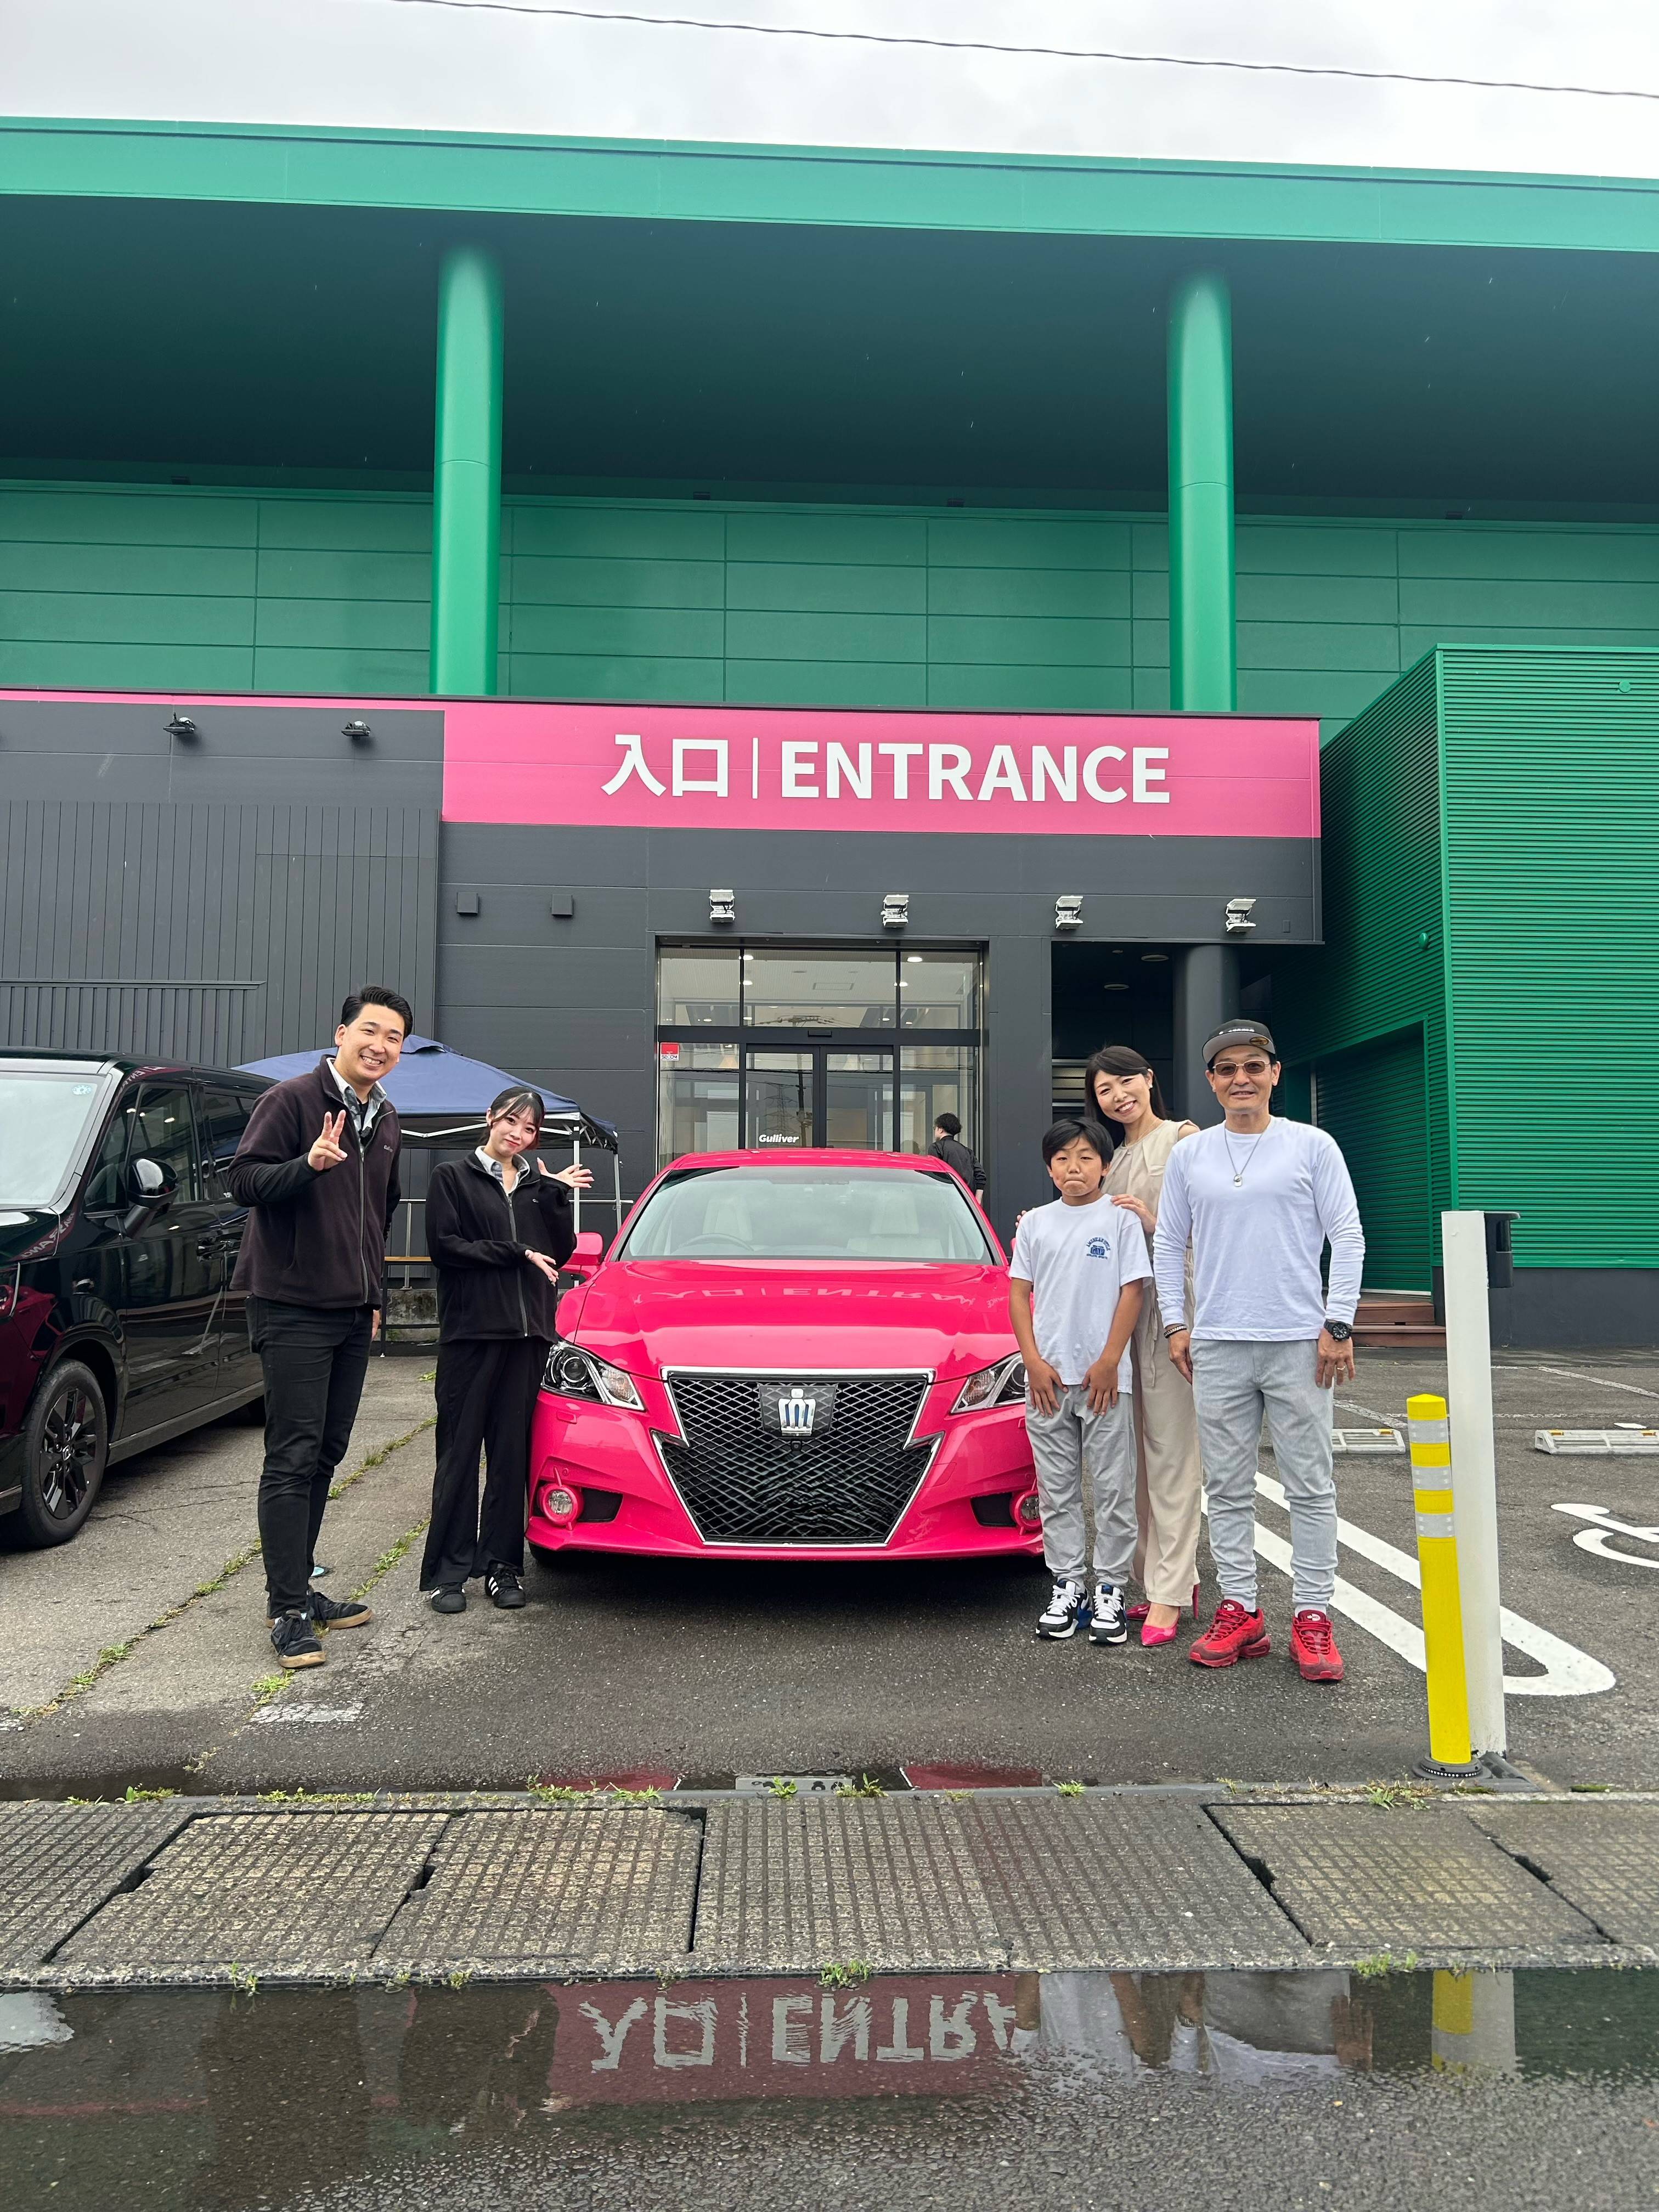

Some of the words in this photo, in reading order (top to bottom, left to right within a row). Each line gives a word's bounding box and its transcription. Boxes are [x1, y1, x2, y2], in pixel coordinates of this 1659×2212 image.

[600, 734, 729, 797] 入口
[781, 741, 1170, 803] ENTRANCE
[759, 1133, 799, 1143] Gulliver
